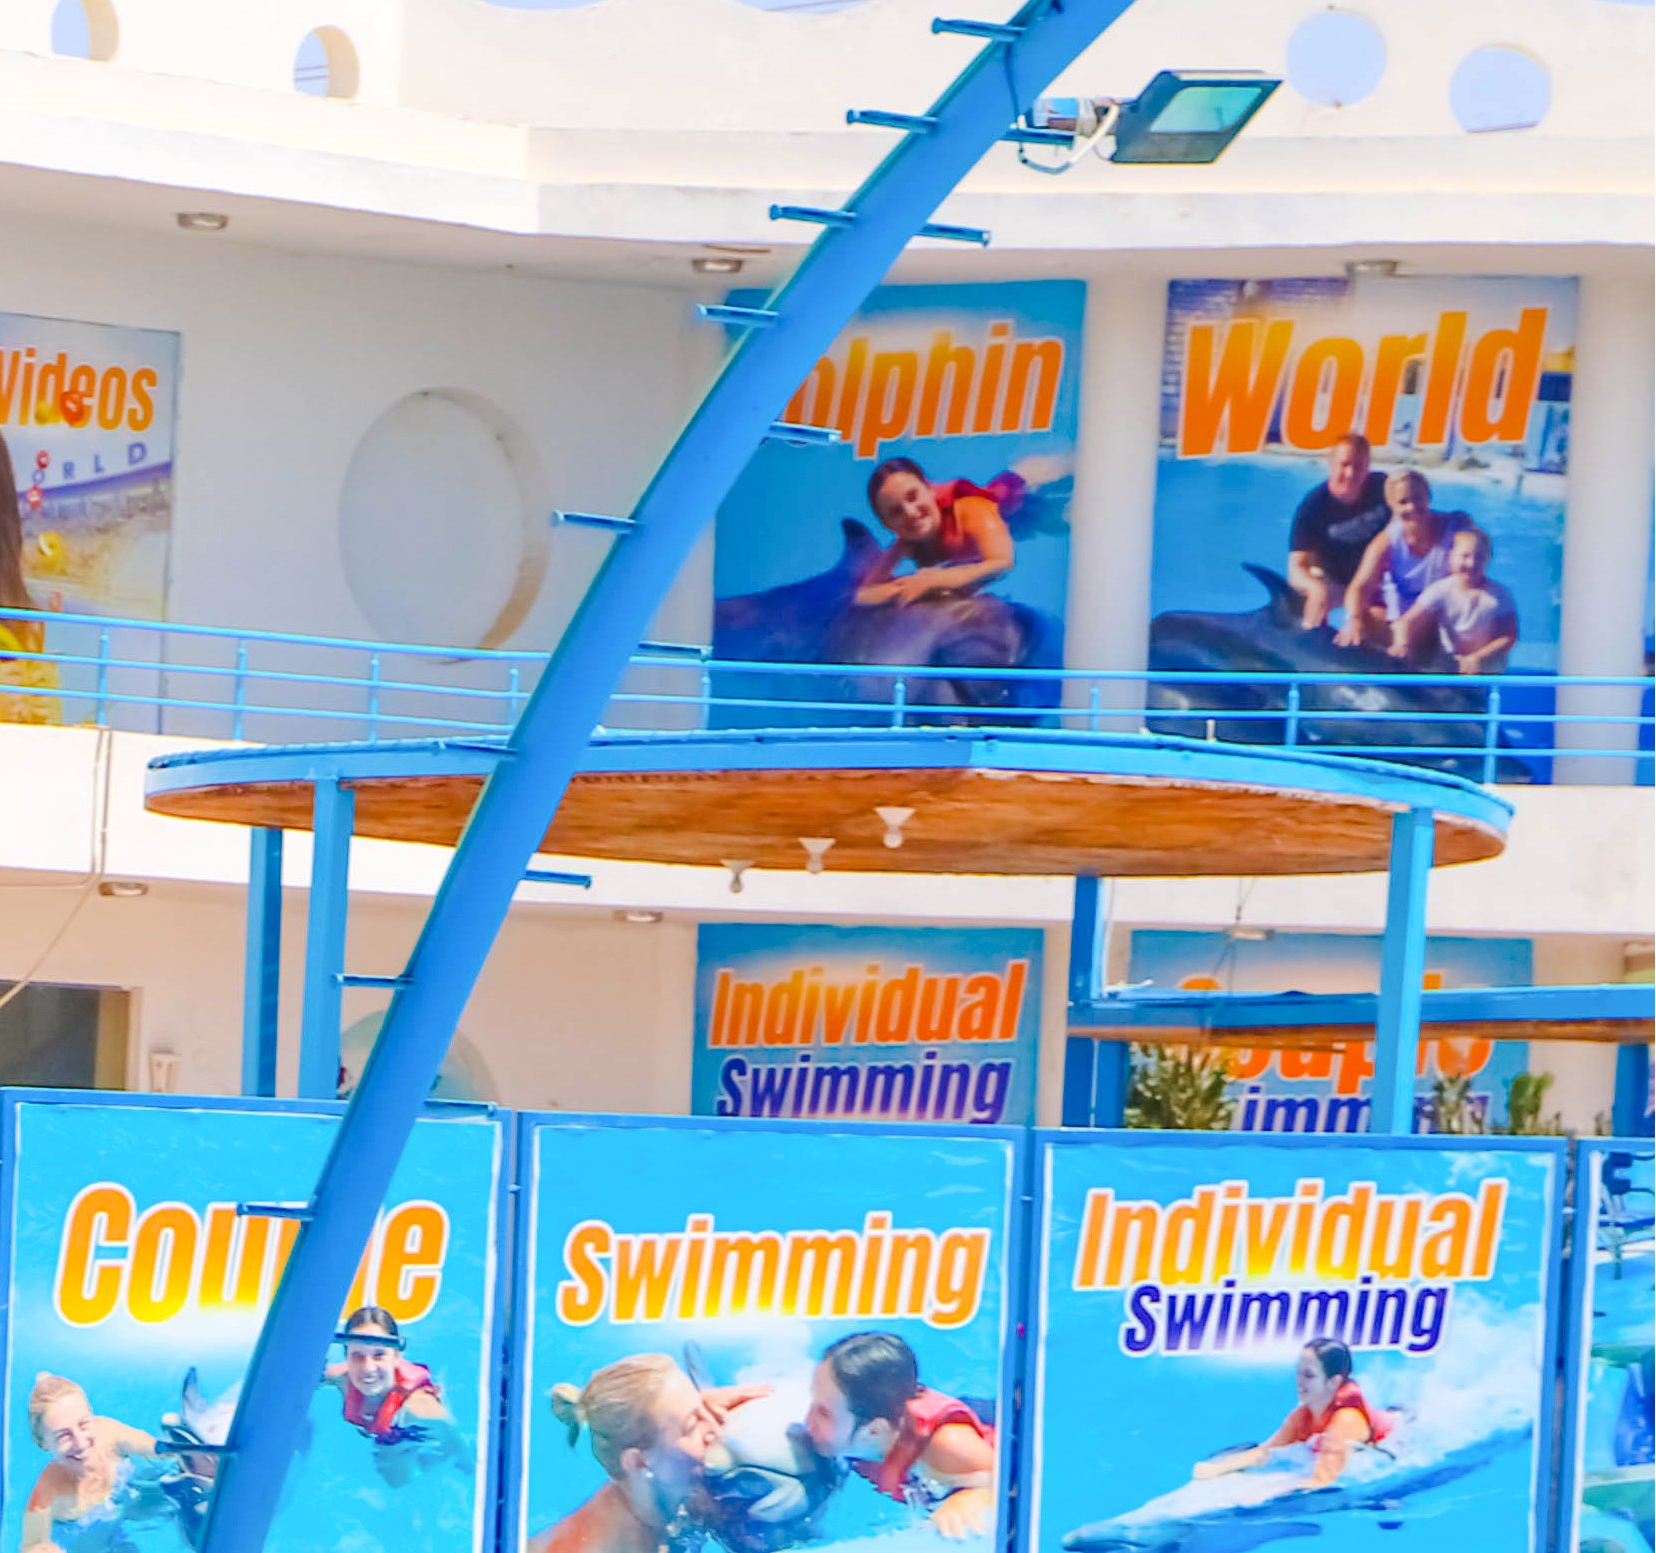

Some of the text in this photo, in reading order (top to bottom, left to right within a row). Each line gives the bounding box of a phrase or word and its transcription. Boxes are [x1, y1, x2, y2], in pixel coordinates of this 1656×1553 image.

[781, 321, 1064, 459] olphin
[1181, 307, 1549, 457] World
[708, 961, 1028, 1046] Individual
[716, 1050, 1013, 1124] Swimming
[560, 1215, 987, 1326] Swimming
[1076, 1181, 1506, 1288] Individual
[1123, 1278, 1449, 1354] Swimming
